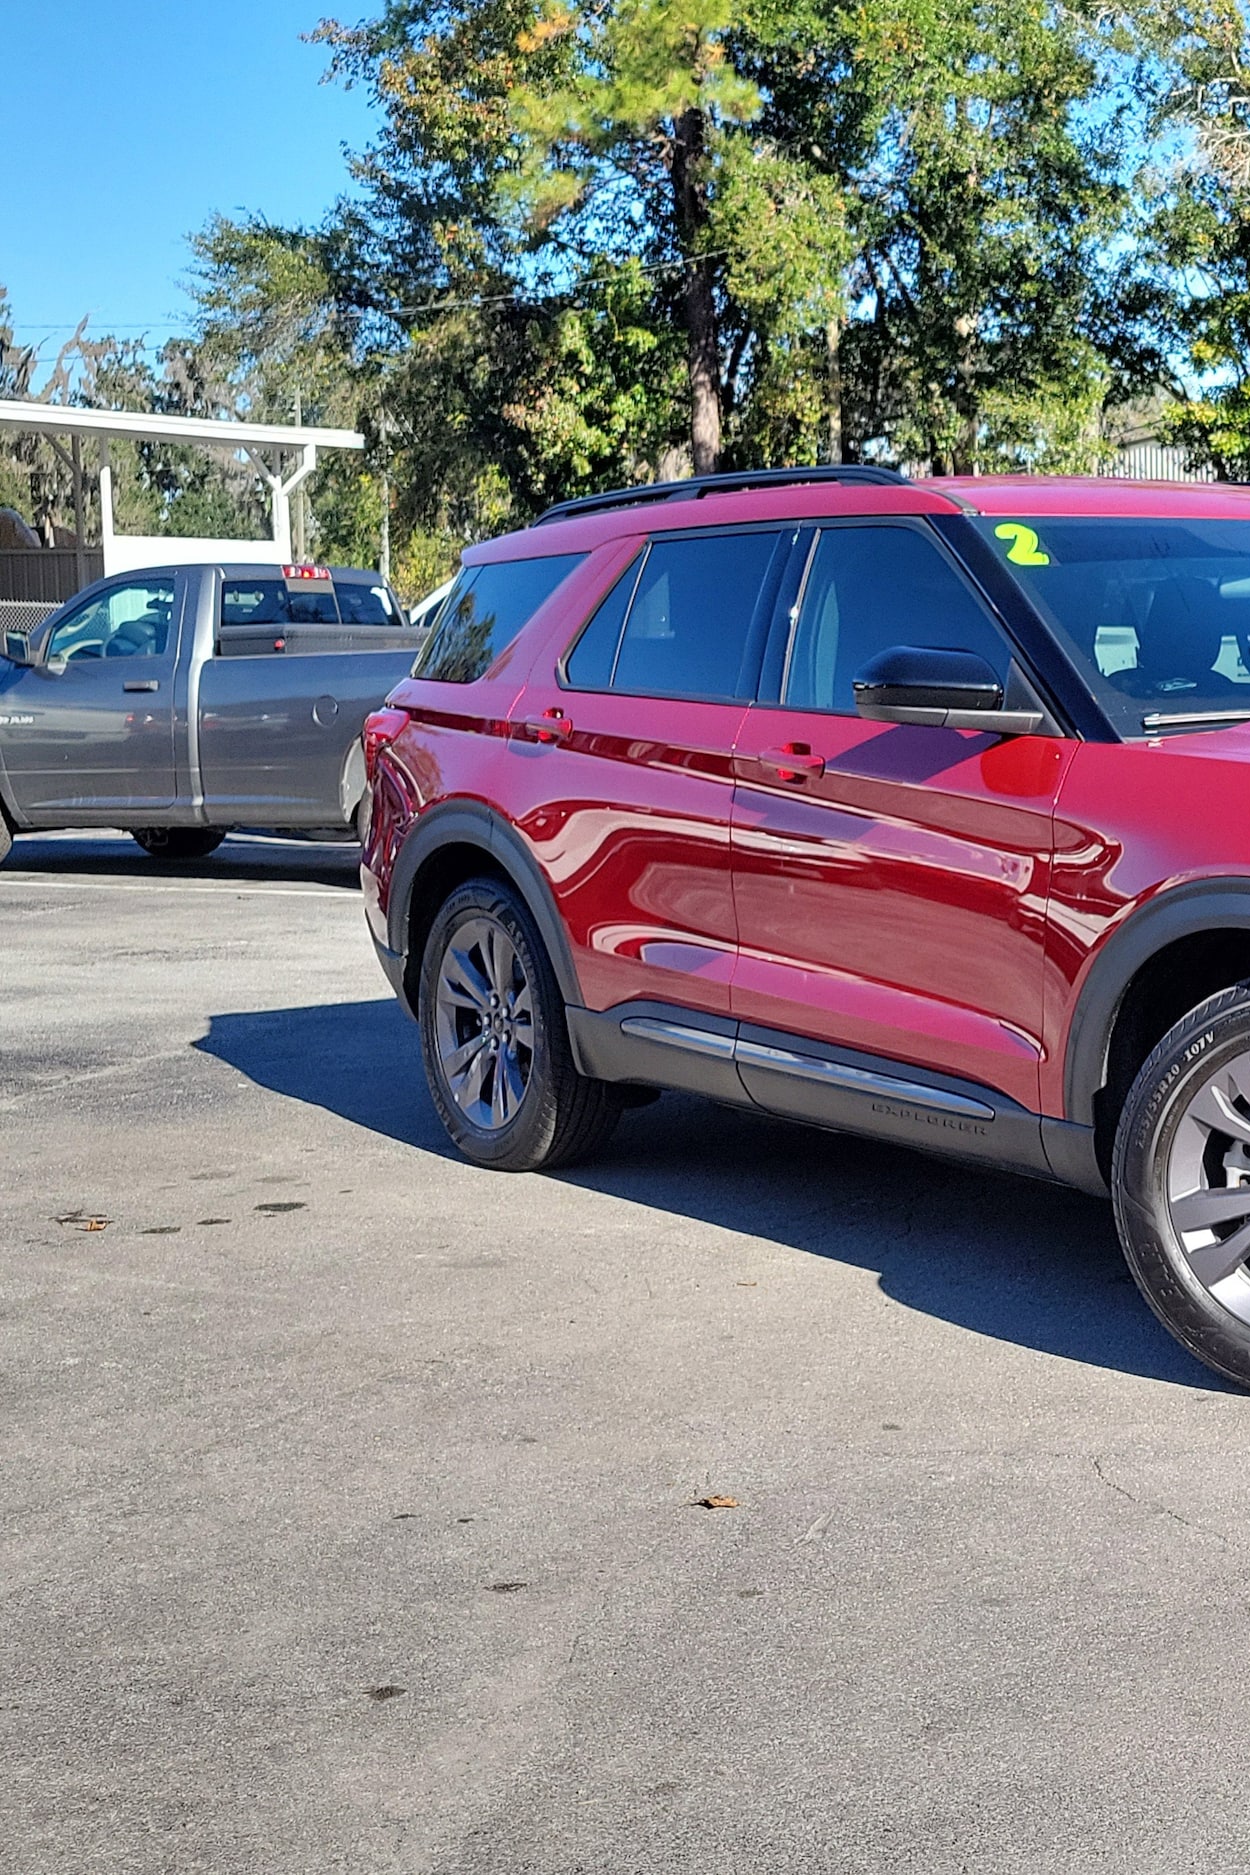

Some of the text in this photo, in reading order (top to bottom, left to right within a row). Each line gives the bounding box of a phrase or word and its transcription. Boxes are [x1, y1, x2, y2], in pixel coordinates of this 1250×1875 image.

[994, 522, 1050, 567] 2
[1182, 1031, 1215, 1063] 107V
[871, 1103, 988, 1136] EXPLORER
